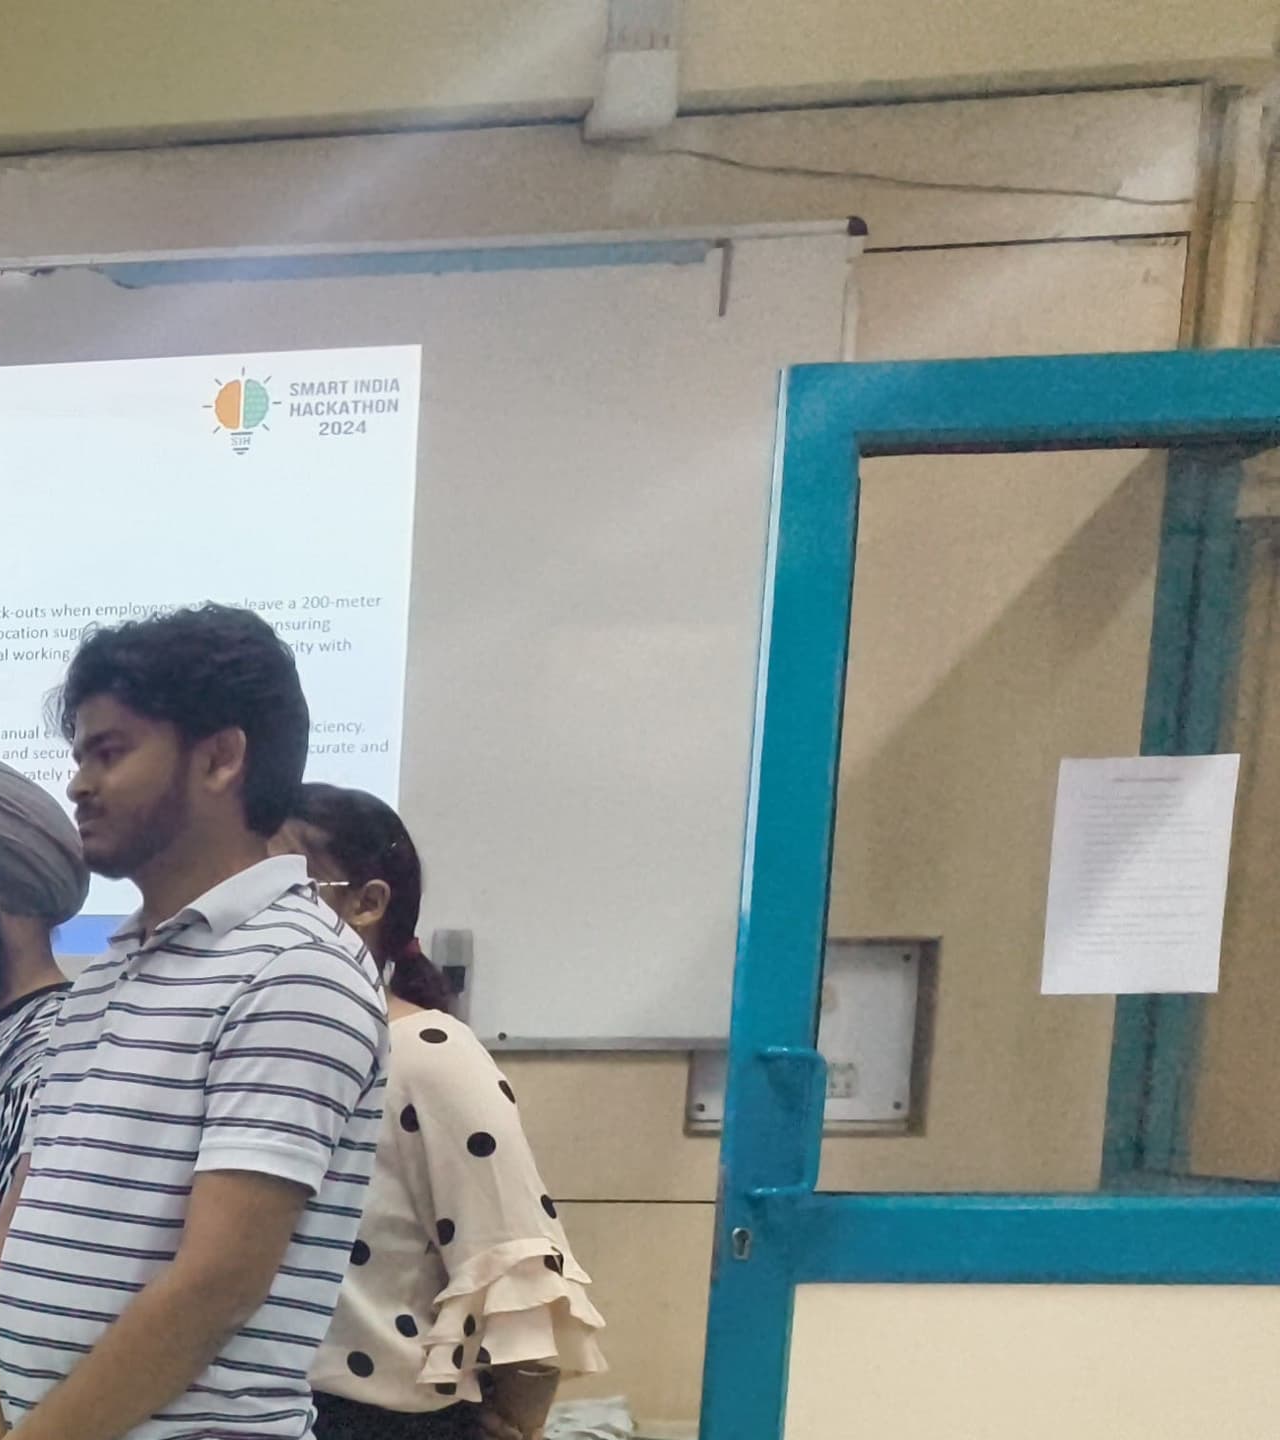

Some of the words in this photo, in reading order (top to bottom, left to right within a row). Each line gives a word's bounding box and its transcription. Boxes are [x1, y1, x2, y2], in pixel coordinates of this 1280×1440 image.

[289, 380, 349, 397] SMART
[354, 378, 400, 394] INDIA
[289, 398, 399, 417] HACKATHON
[318, 420, 367, 436] 2024
[51, 603, 91, 617] when
[302, 595, 382, 610] 200-meter
[13, 648, 70, 664] working
[319, 637, 352, 652] with
[2, 747, 28, 761] and
[360, 739, 389, 753] and
